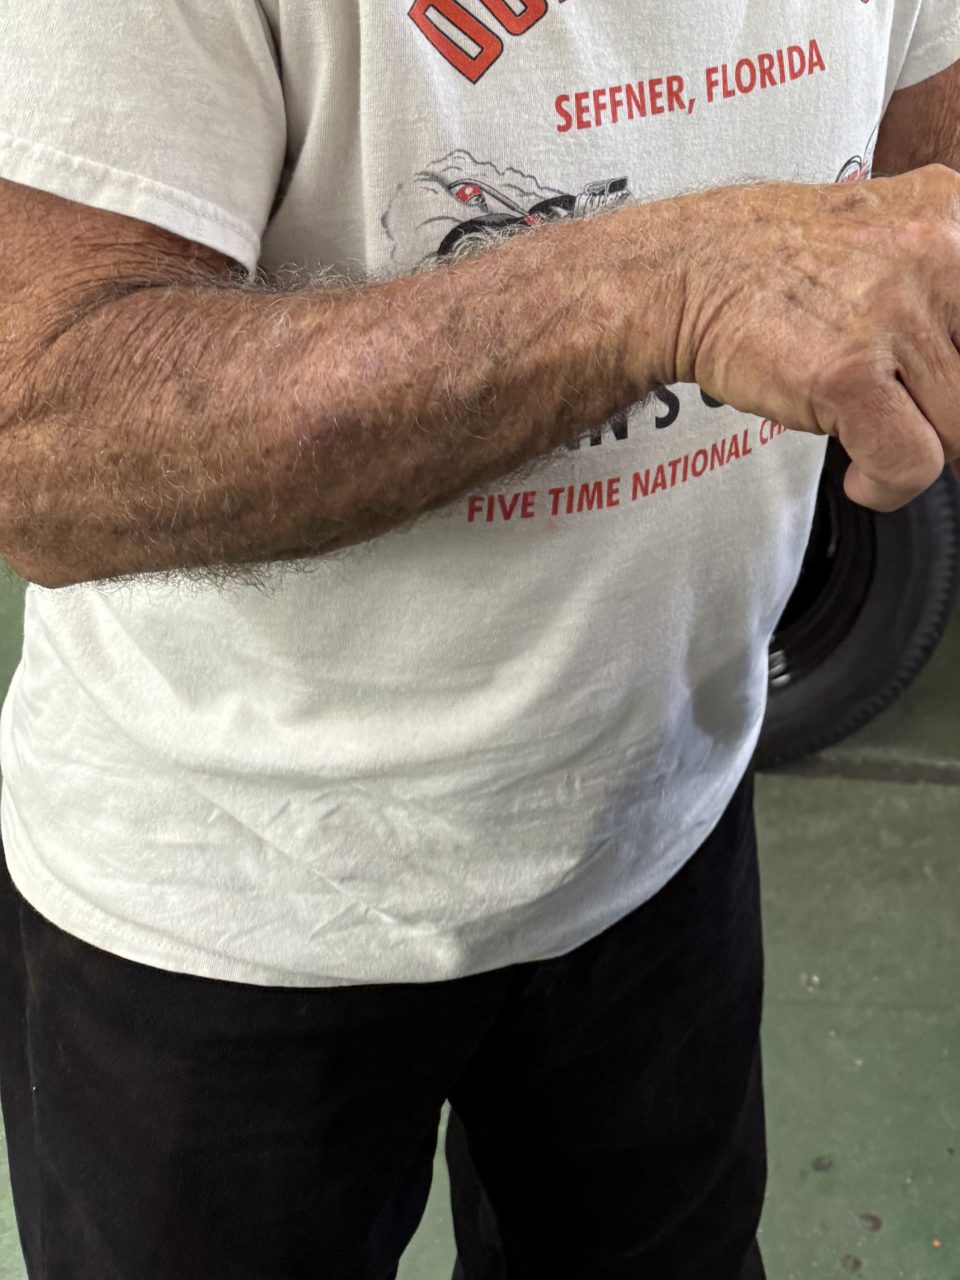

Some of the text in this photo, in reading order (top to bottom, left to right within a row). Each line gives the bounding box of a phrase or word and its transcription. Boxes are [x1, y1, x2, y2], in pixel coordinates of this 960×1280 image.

[554, 39, 826, 133] SEFFNER, FLORIDA
[467, 420, 789, 523] FIVE TIME NATIONAL CH
